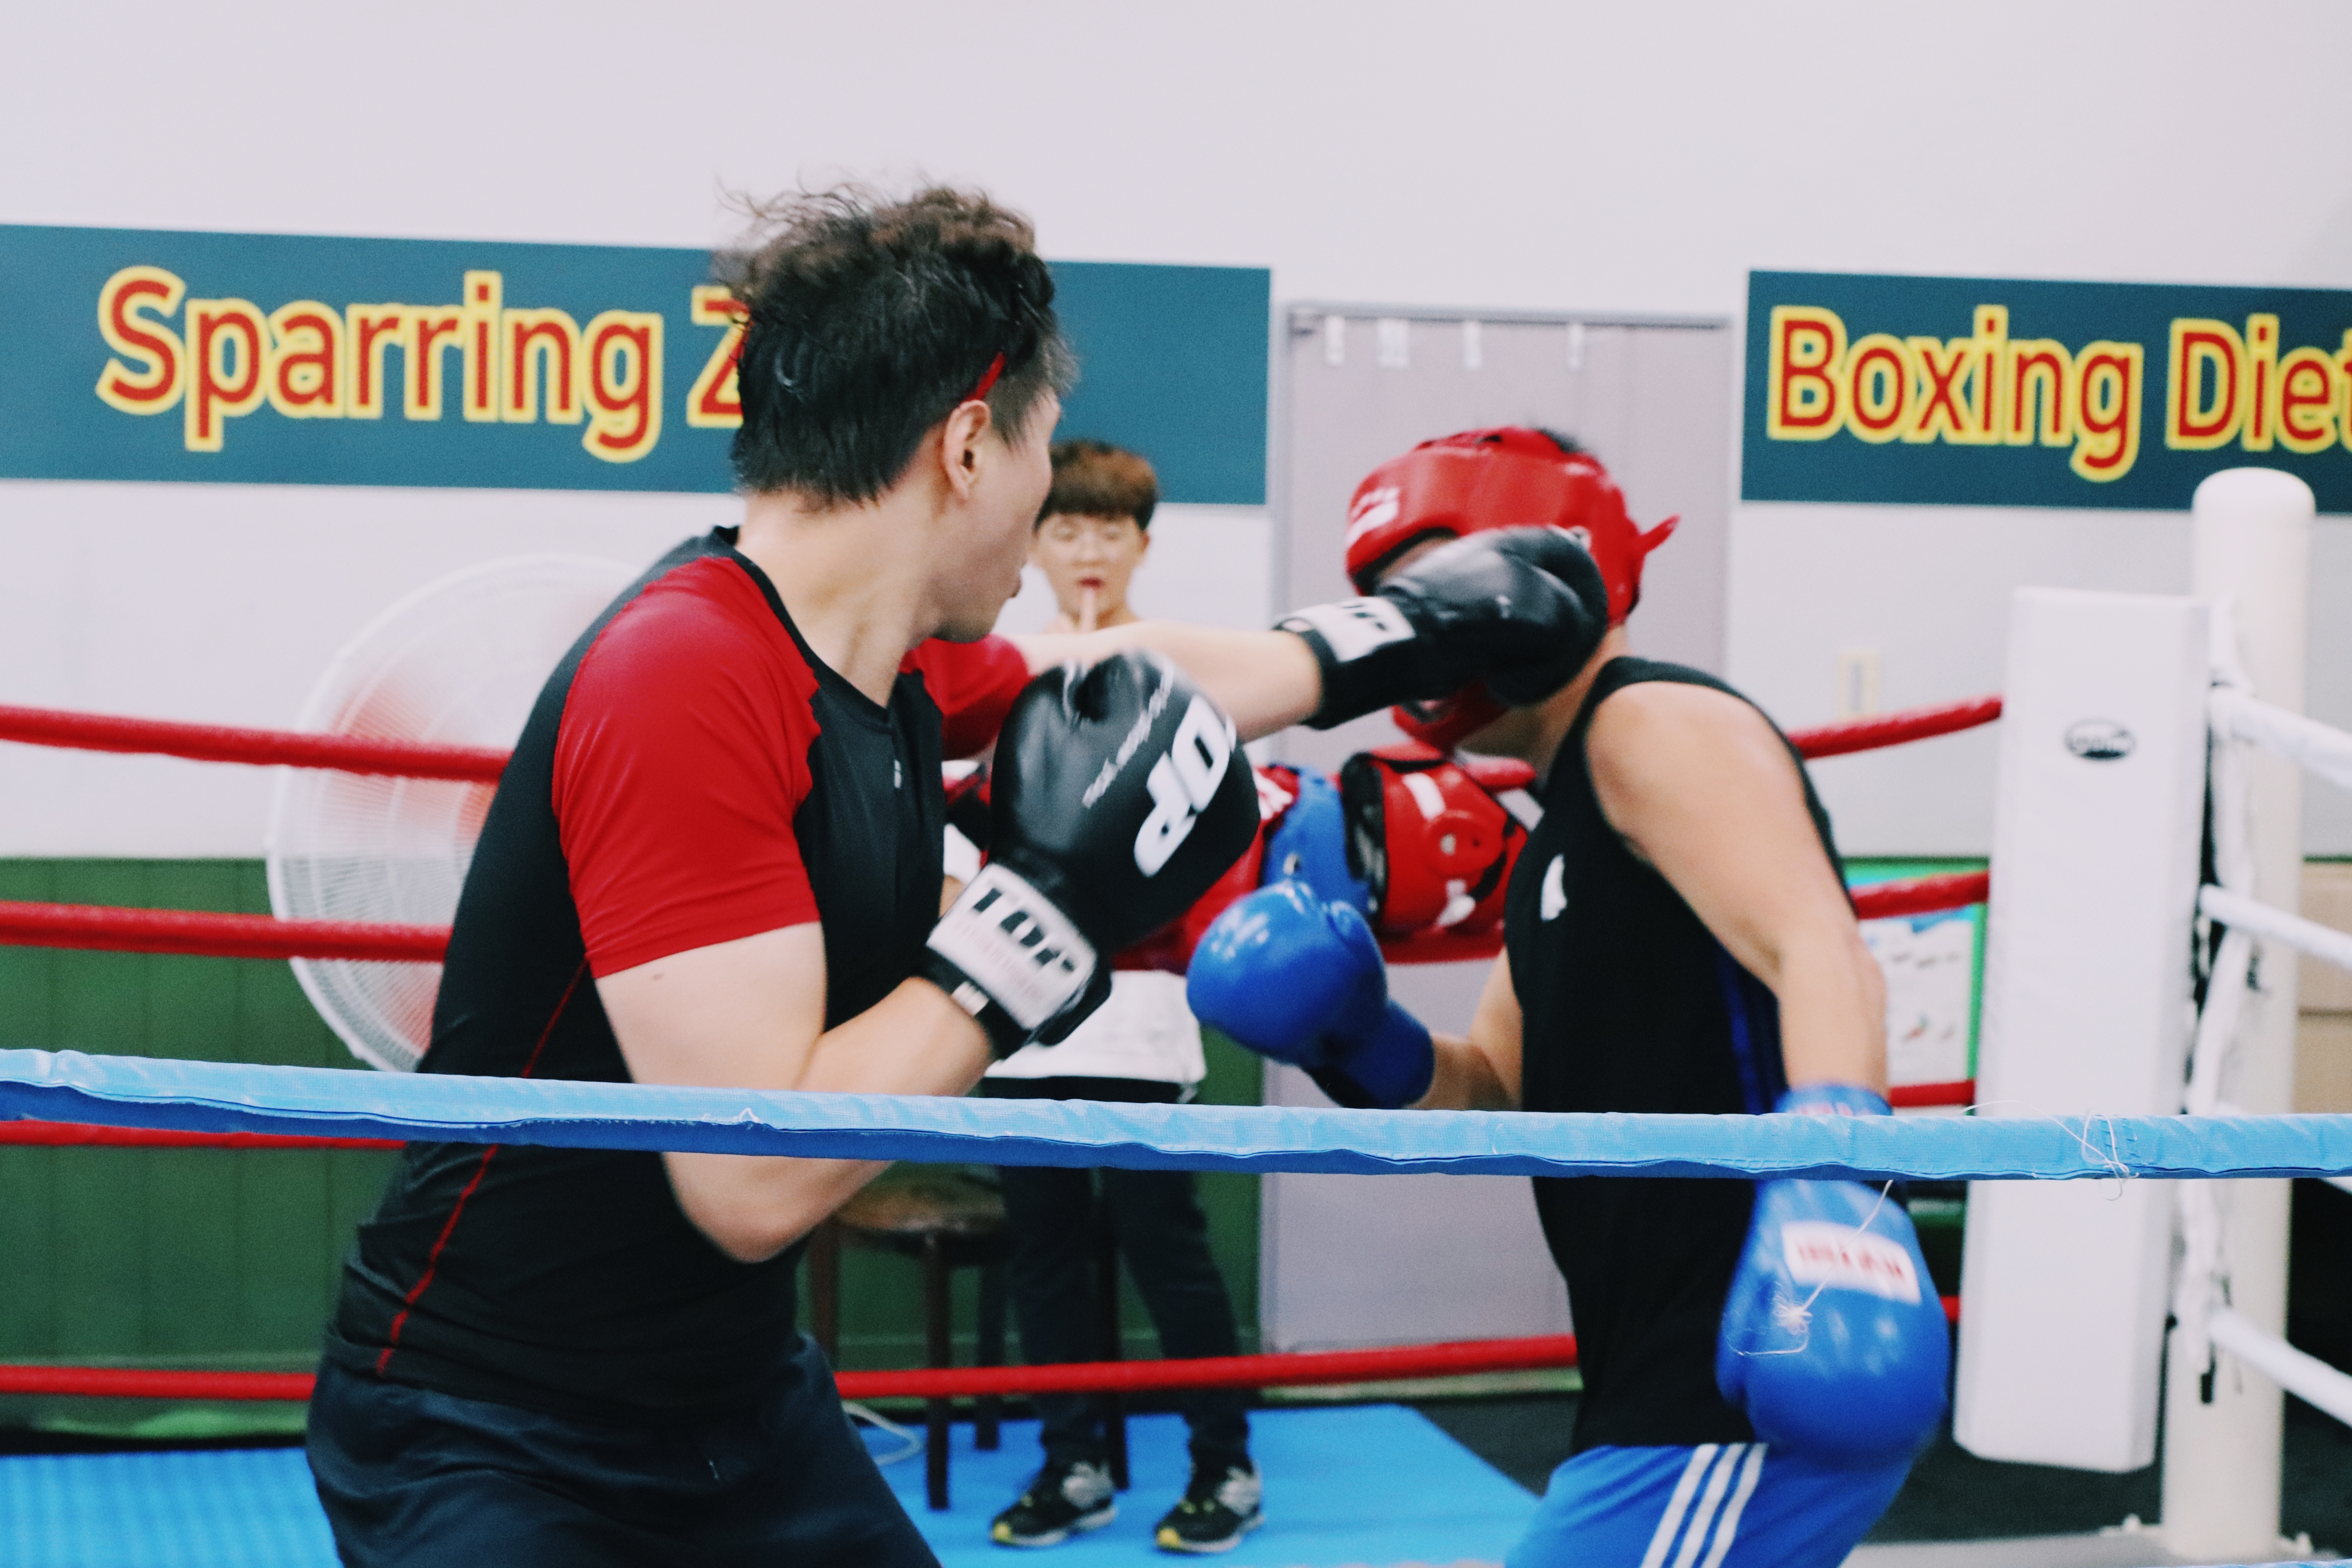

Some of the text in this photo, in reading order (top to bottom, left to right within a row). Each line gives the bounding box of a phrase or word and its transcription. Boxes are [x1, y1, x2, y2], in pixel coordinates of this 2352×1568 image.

[96, 265, 664, 463] Sparring
[1767, 304, 2144, 482] Boxing
[1134, 693, 1236, 877] OP
